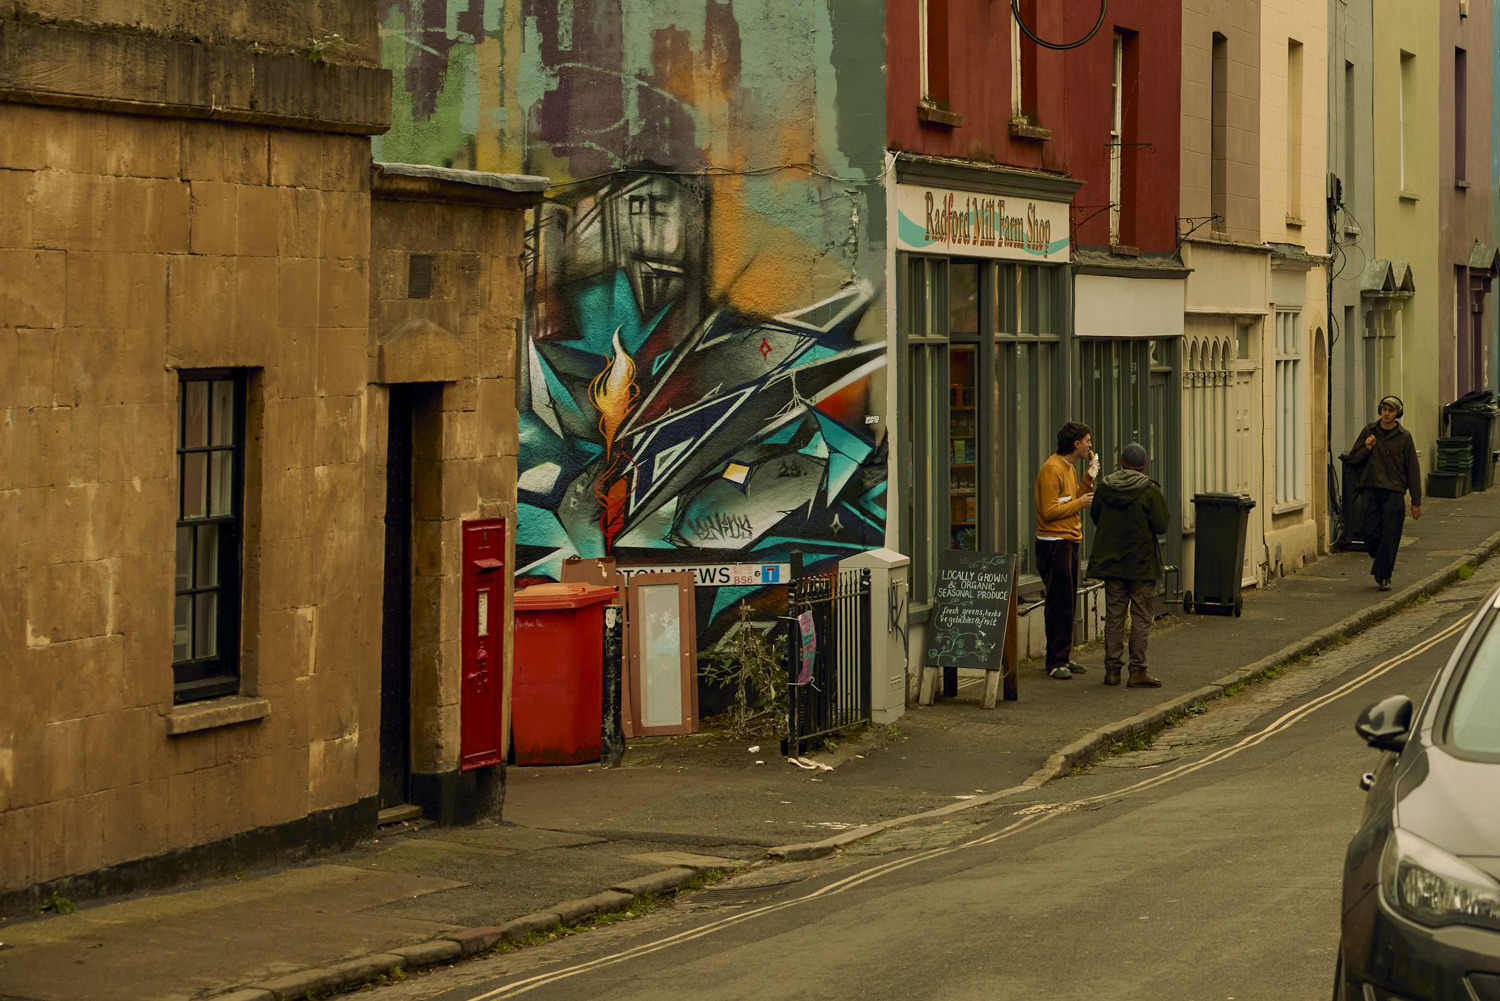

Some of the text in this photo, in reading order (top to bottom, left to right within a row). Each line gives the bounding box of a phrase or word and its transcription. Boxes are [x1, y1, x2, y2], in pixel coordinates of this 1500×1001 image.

[924, 191, 1052, 259] Radford Mill Farm Shop
[733, 576, 753, 585] BS6
[942, 570, 1008, 582] LOCALLY GROWN
[948, 580, 995, 590] & ORGANIC
[937, 588, 1008, 601] SEASONAL PRODUCE
[942, 606, 959, 616] fresh
